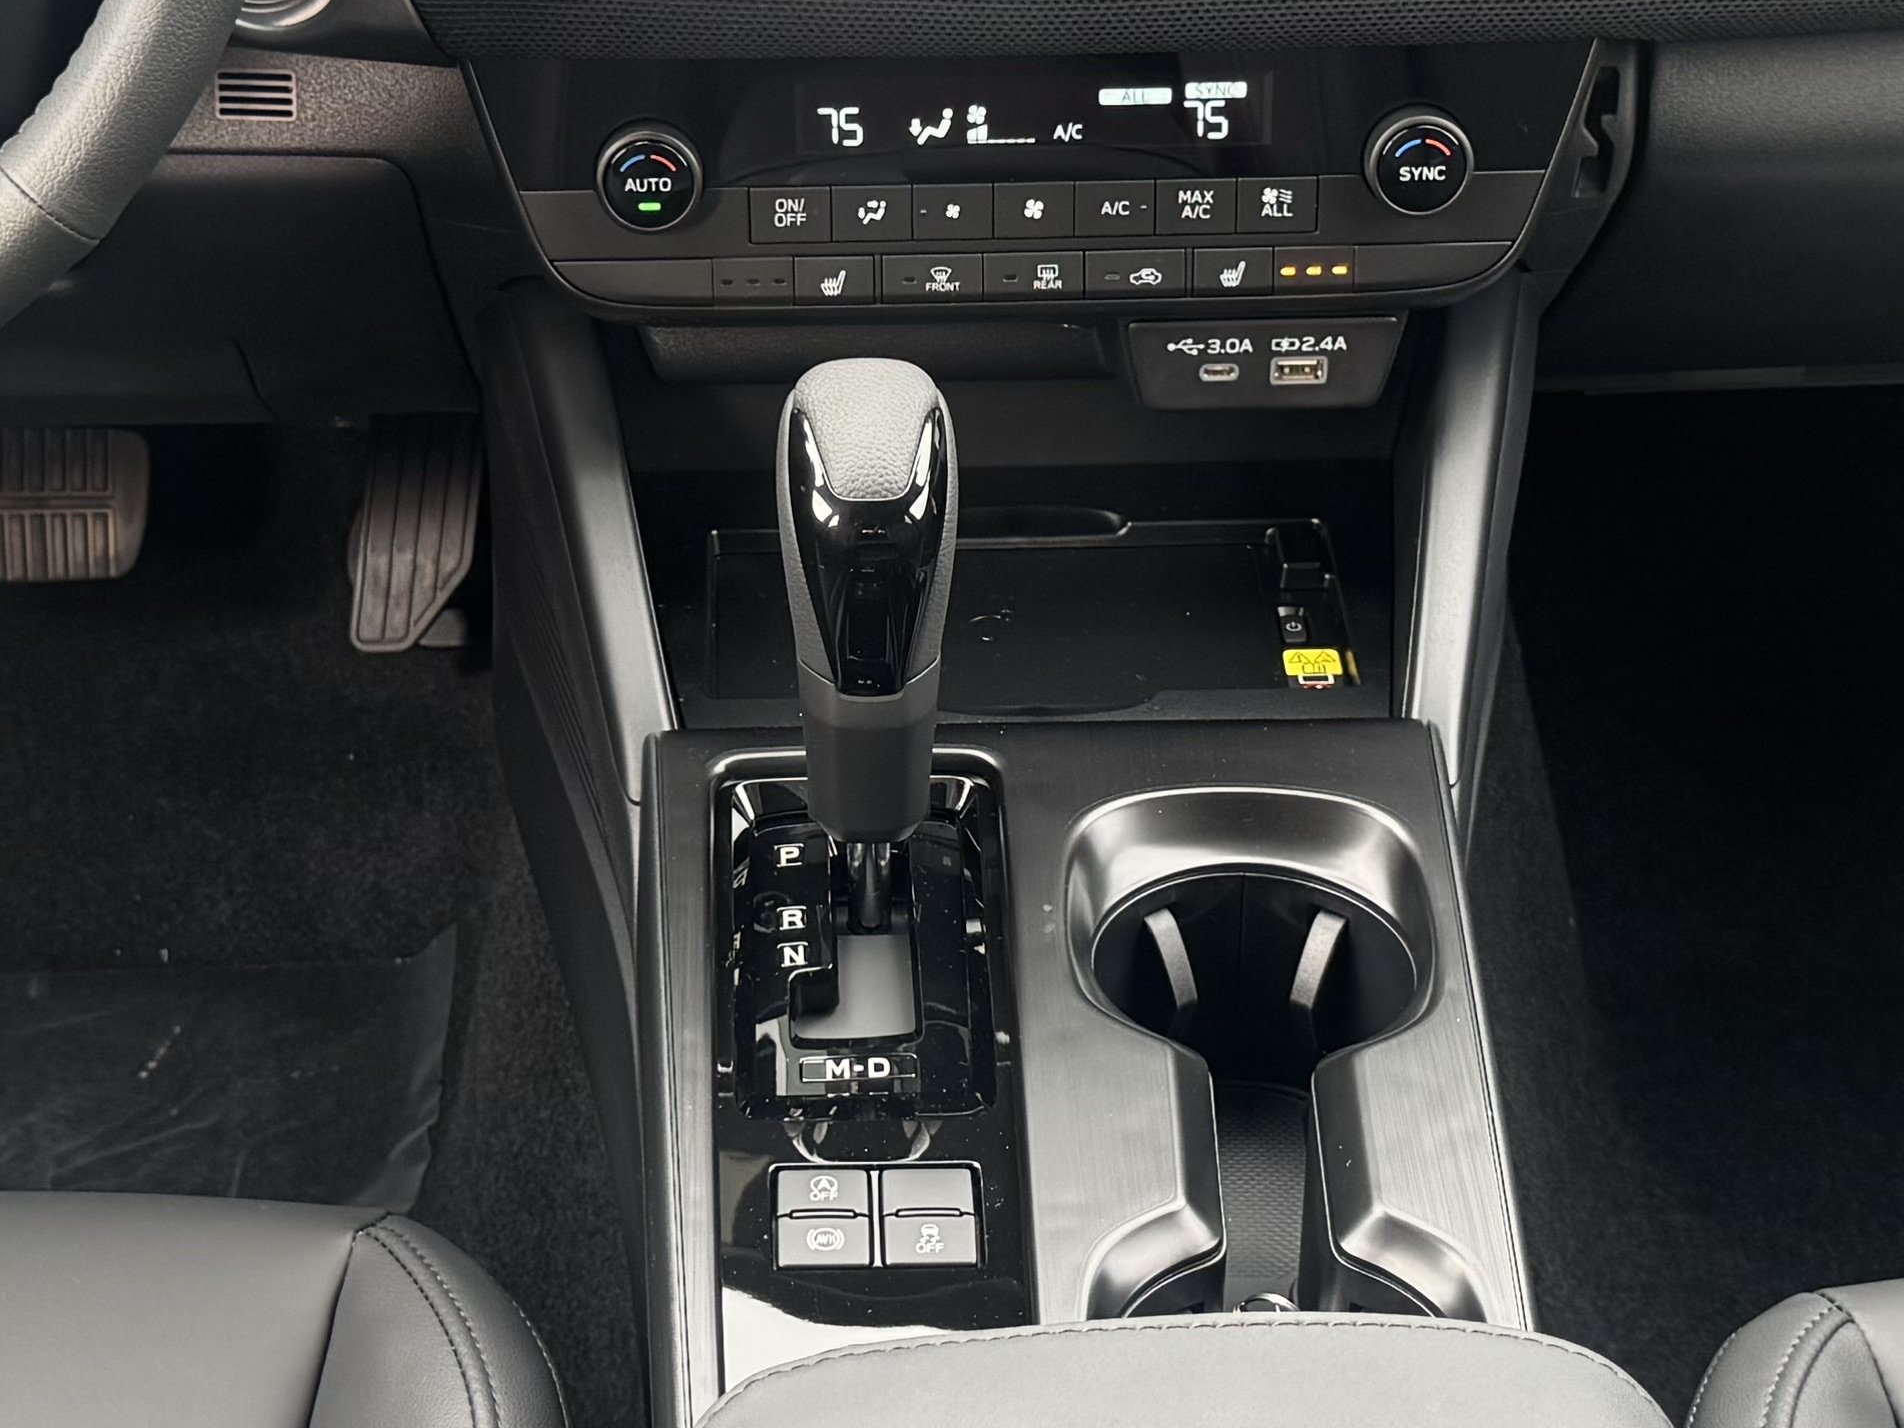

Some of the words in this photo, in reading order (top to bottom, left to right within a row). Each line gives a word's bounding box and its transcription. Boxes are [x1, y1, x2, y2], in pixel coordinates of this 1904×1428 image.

[817, 106, 864, 147] 75
[1183, 100, 1229, 139] 75
[1053, 123, 1083, 141] A/C
[1399, 166, 1446, 182] SYNC
[625, 177, 672, 193] AUTO
[1178, 190, 1214, 205] MAX
[775, 197, 805, 216] ON/
[1101, 201, 1130, 216] A/C
[1181, 204, 1211, 220] A/C
[1261, 203, 1293, 218] ALL
[774, 213, 807, 227] OFF
[925, 281, 960, 293] FRONT
[1033, 279, 1062, 290] REAR
[1207, 339, 1253, 354] 3.0A
[1300, 337, 1347, 352] 2.4A
[778, 846, 800, 865] P
[783, 909, 804, 928] R
[783, 946, 805, 965] N
[809, 1191, 838, 1201] OFF
[915, 1242, 944, 1253] OFF
